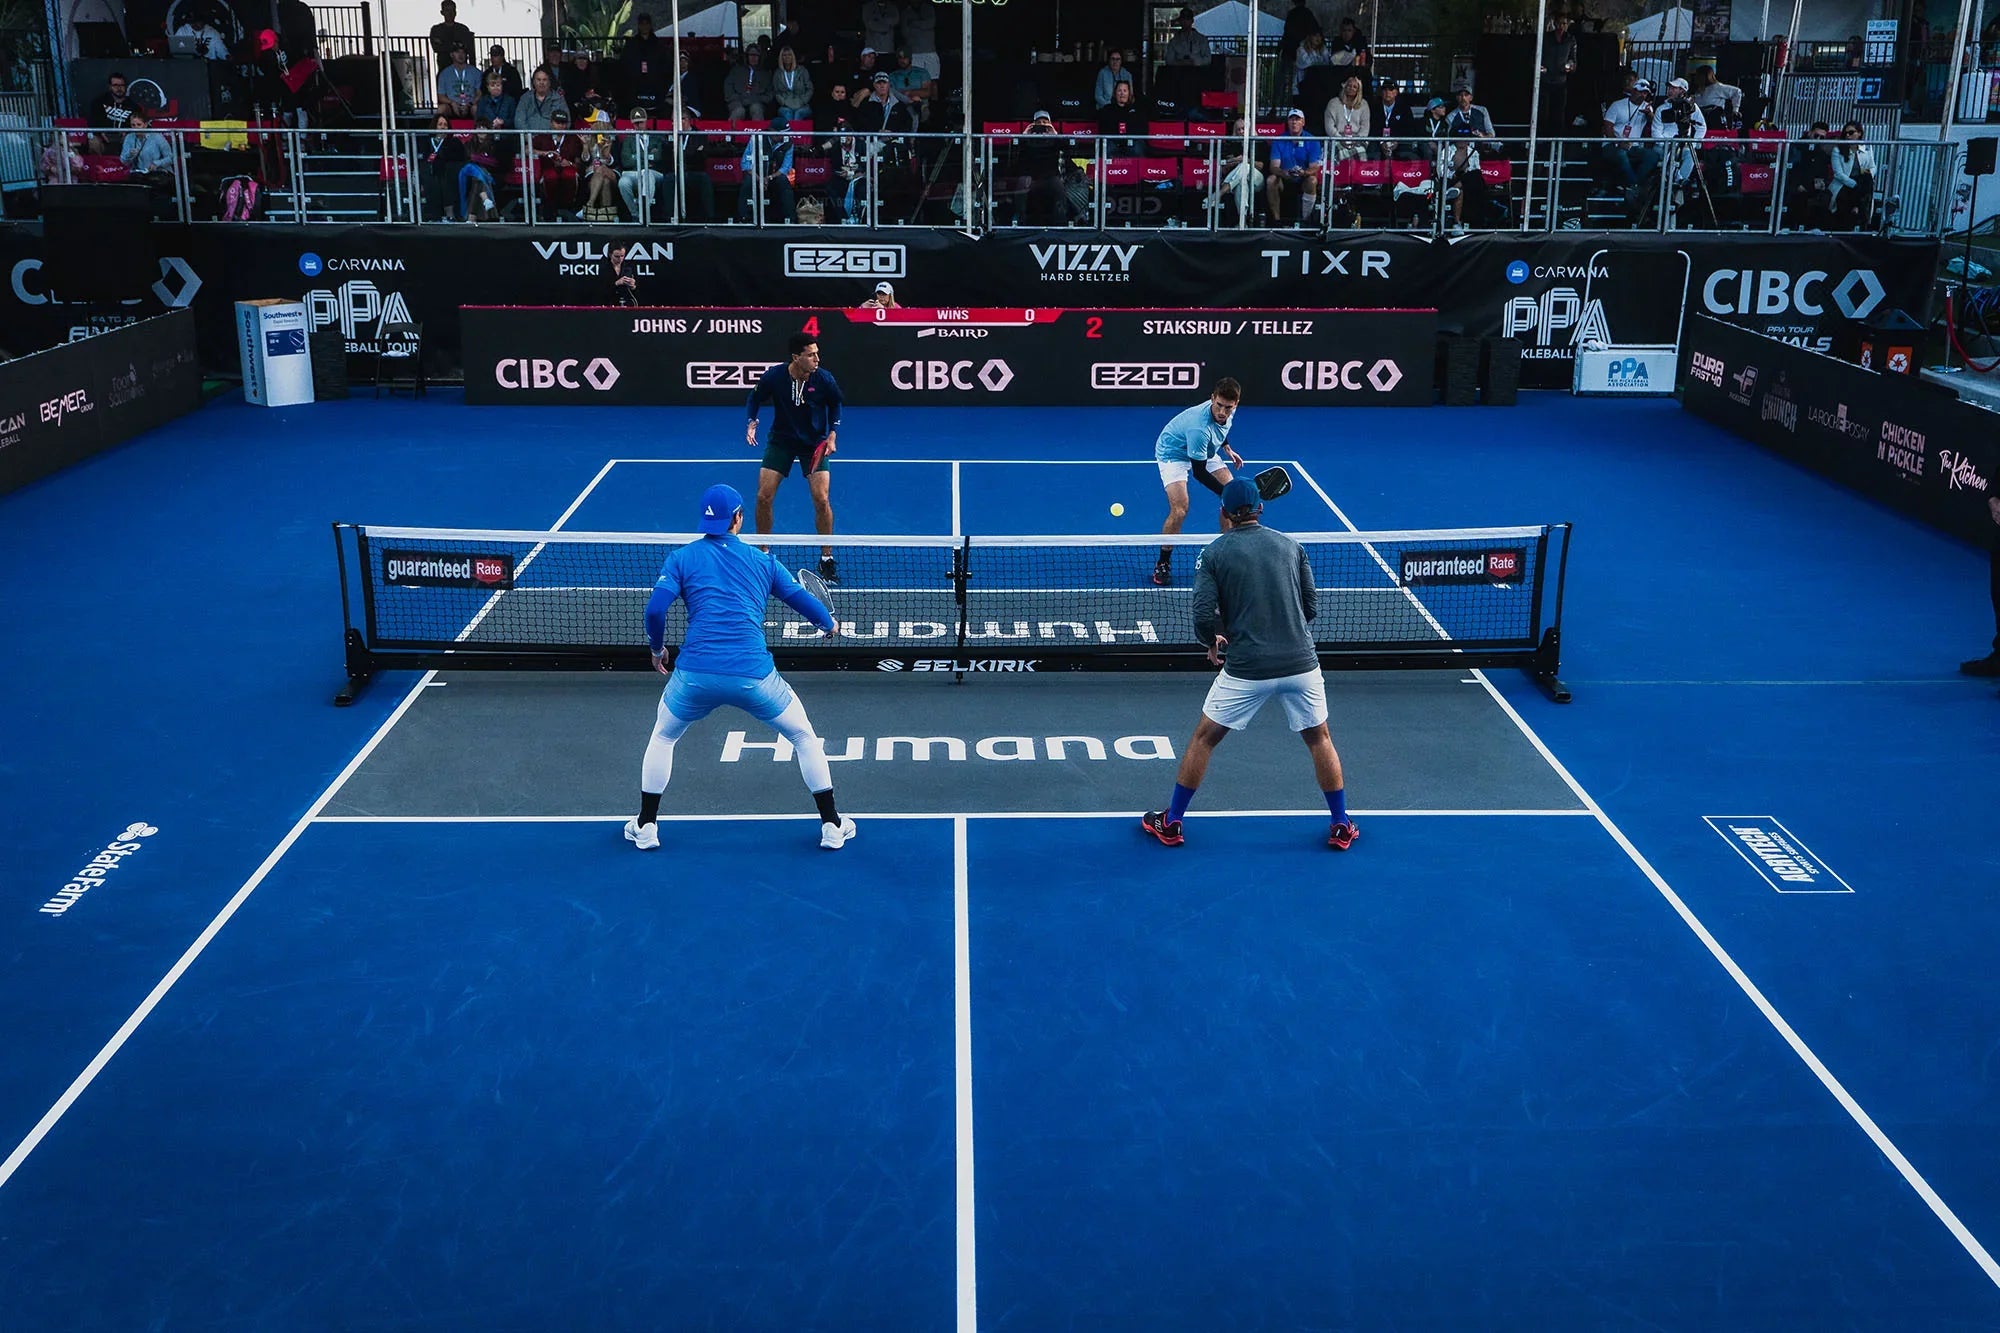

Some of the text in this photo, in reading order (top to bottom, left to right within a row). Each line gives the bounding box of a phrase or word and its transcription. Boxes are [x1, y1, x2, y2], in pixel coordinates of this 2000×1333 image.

[327, 258, 405, 271] CARVANA
[793, 250, 897, 272] EZGO
[1028, 244, 1139, 271] VIZZY
[1261, 250, 1392, 279] TIXR
[1041, 273, 1130, 282] HARD SELTZER
[1534, 266, 1609, 278] CARVANA
[1703, 269, 1828, 316] CIBC
[263, 311, 297, 320] Southwest
[302, 280, 420, 340] PPA
[876, 308, 886, 321] 0
[937, 309, 969, 320] WINS
[1025, 308, 1035, 321] 0
[1502, 287, 1612, 346] PPA
[632, 319, 687, 333] JOHNS
[707, 319, 763, 333] JOHNS
[802, 315, 821, 338] 4
[938, 328, 989, 339] BAIRD
[1085, 316, 1104, 339] 2
[1143, 320, 1231, 334] STAKSRUD
[1252, 321, 1313, 335] TELLEZ
[244, 310, 257, 387] Southwest
[495, 358, 581, 389] CIBC
[690, 365, 767, 385] EZG
[891, 360, 974, 390] CIBC
[1281, 360, 1364, 390] CIBC
[1608, 358, 1648, 379] PPA
[1692, 352, 1724, 375] DURA
[1095, 366, 1195, 386] EZGO
[1761, 391, 1798, 433] CRUNCH
[1881, 421, 1926, 454] CHICKEN
[1877, 441, 1886, 460] N
[1939, 450, 1952, 474] The
[1949, 452, 1988, 491] Kitchen
[388, 559, 501, 580] guaranteed Rate
[1405, 554, 1515, 581] guaranteed Rate
[782, 620, 1160, 643] Humana
[912, 659, 1037, 673] SELKIRK
[720, 731, 1176, 762] Humana
[1730, 825, 1815, 882] ACRYTECH
